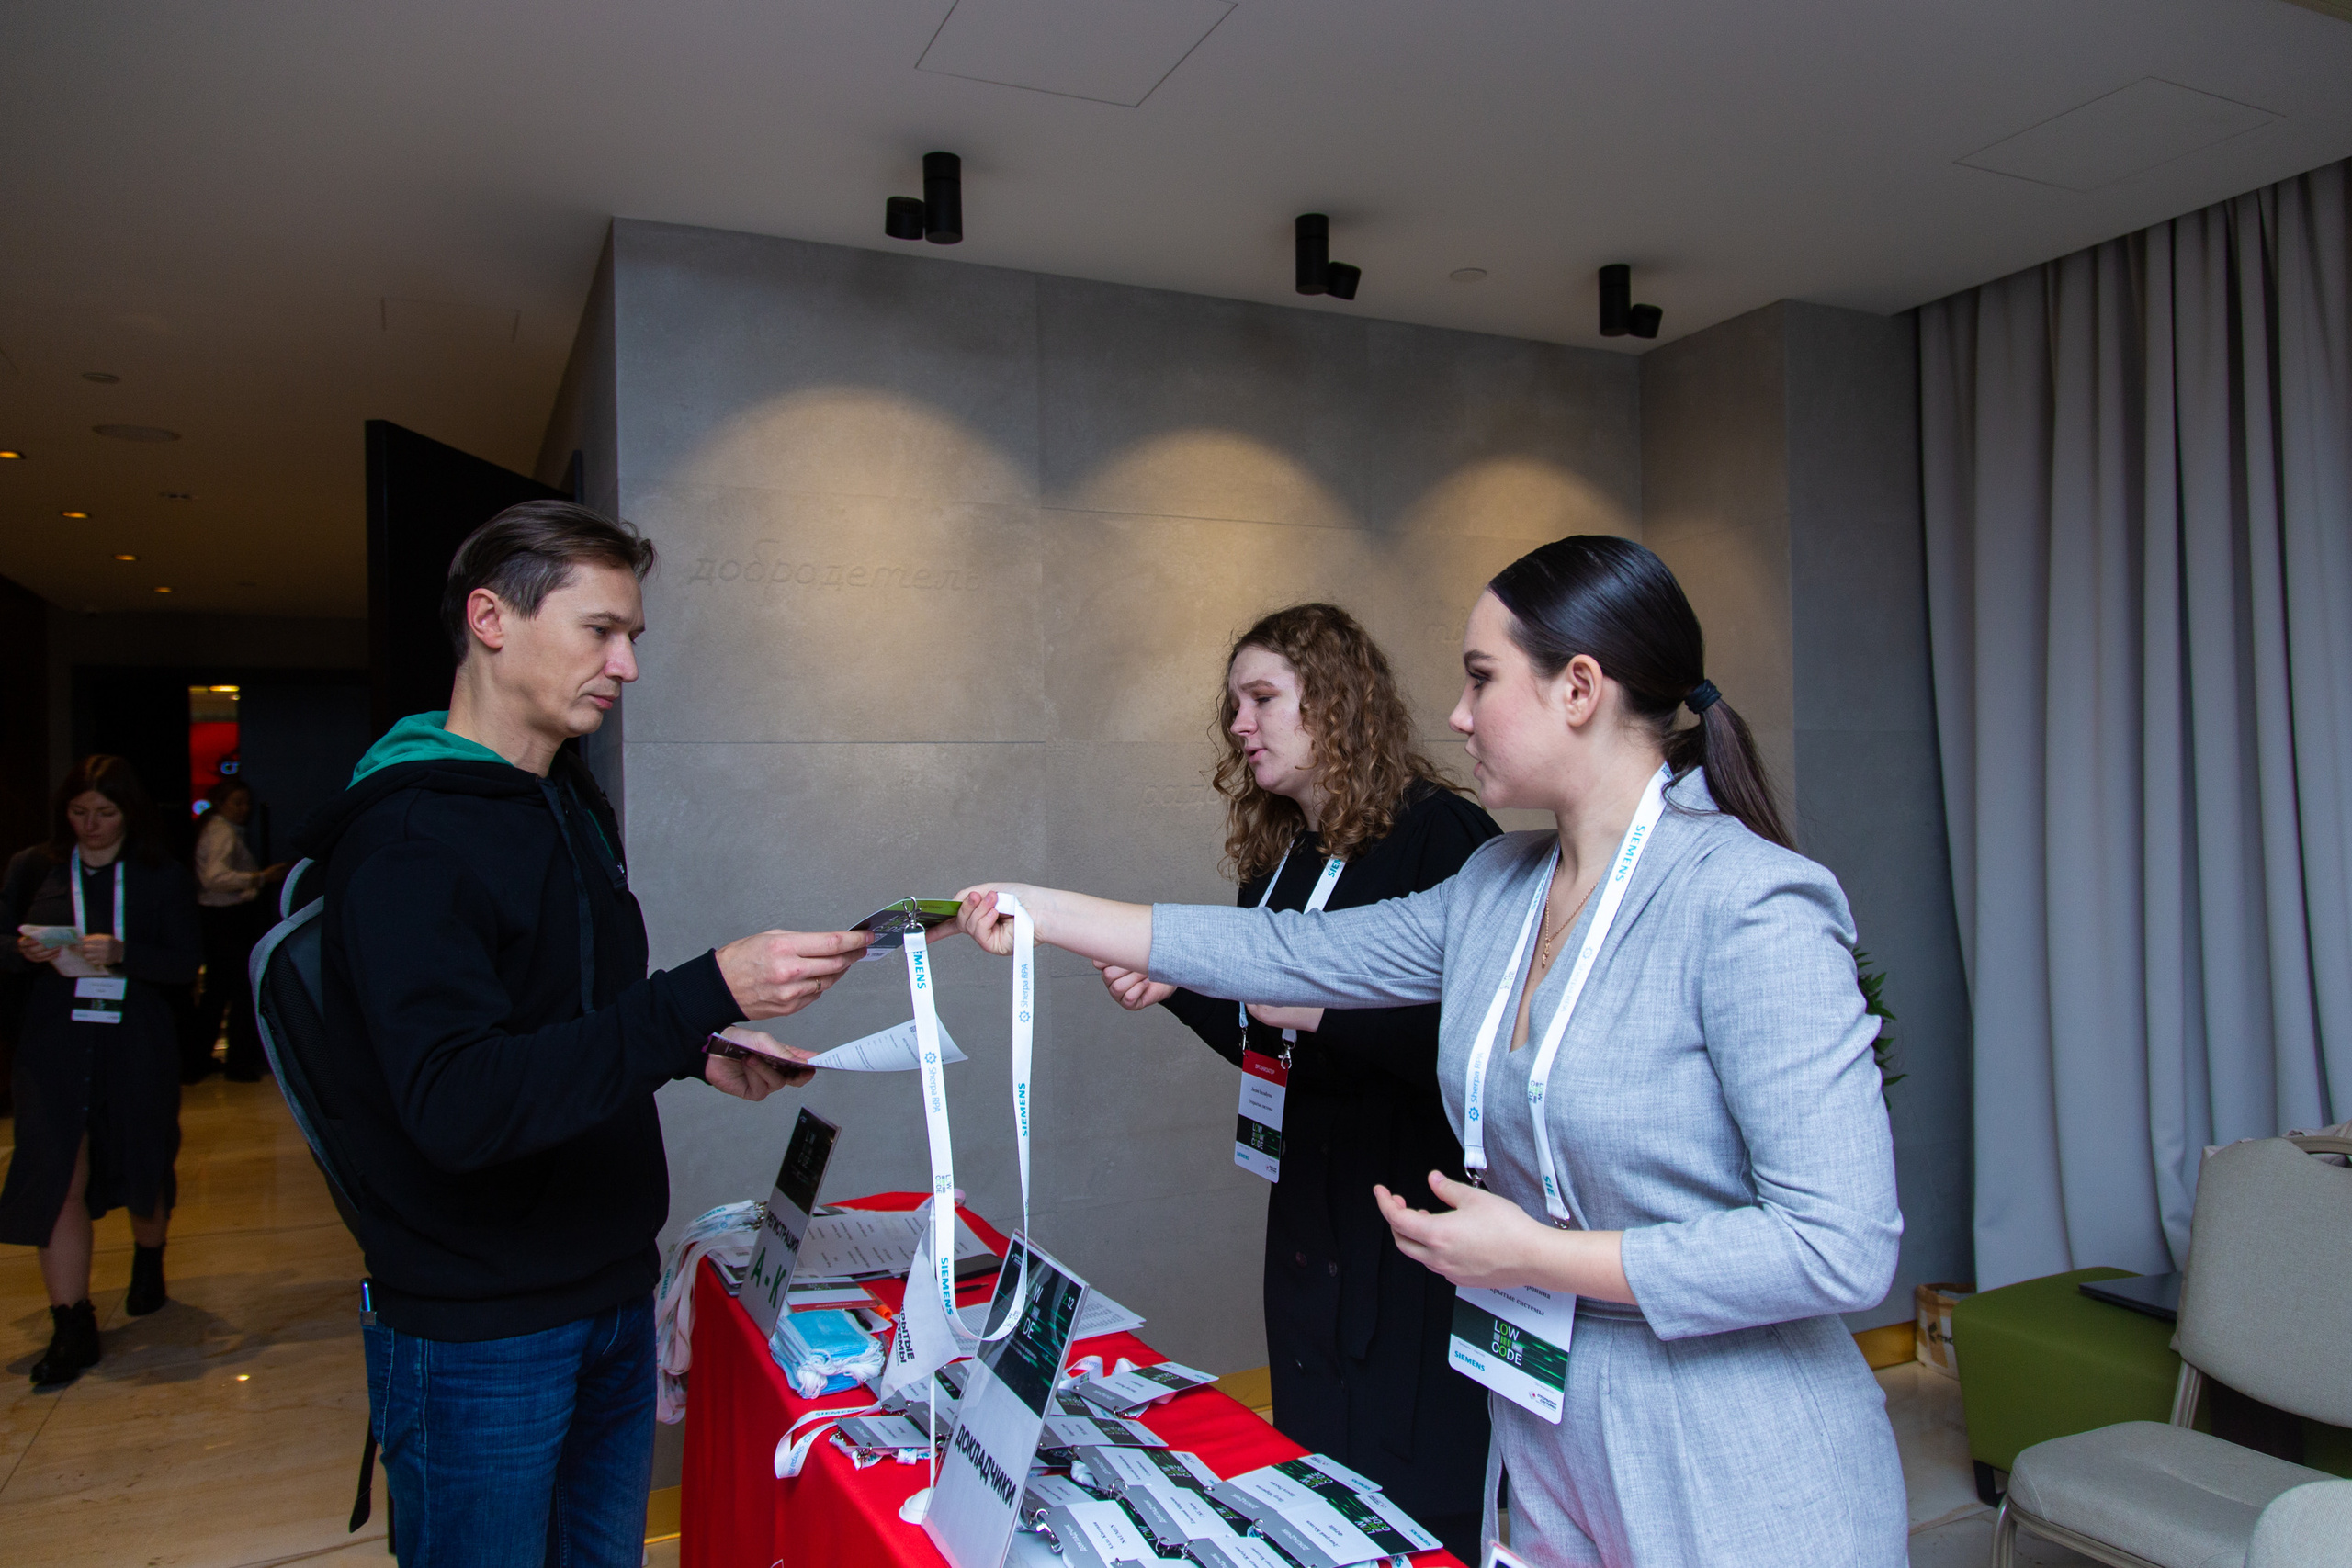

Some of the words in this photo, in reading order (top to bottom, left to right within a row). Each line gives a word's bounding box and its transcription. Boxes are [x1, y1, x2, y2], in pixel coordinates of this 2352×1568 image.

[687, 538, 981, 603] добродетель
[1615, 825, 1645, 883] SIEMENS
[1021, 981, 1029, 1008] Sherpa
[928, 1067, 937, 1097] Sherpa
[933, 1097, 941, 1112] RPA
[1471, 1069, 1480, 1103] Sherpa
[1018, 1082, 1028, 1137] SIEMENS
[767, 1210, 800, 1254] РЕГИСТРАЦИЯ
[941, 1257, 953, 1315] SIEMENS
[1488, 1287, 1515, 1303] крытые
[1516, 1298, 1544, 1316] системы
[1494, 1319, 1520, 1341] LOW
[1454, 1349, 1486, 1372] SIEMENS
[1491, 1341, 1522, 1366] CODE
[955, 1424, 1017, 1509] ДОКЛАДЧИКИ
[1138, 1524, 1158, 1541] LOW
[1354, 1520, 1376, 1535] LOW
[1368, 1515, 1391, 1532] CODE
